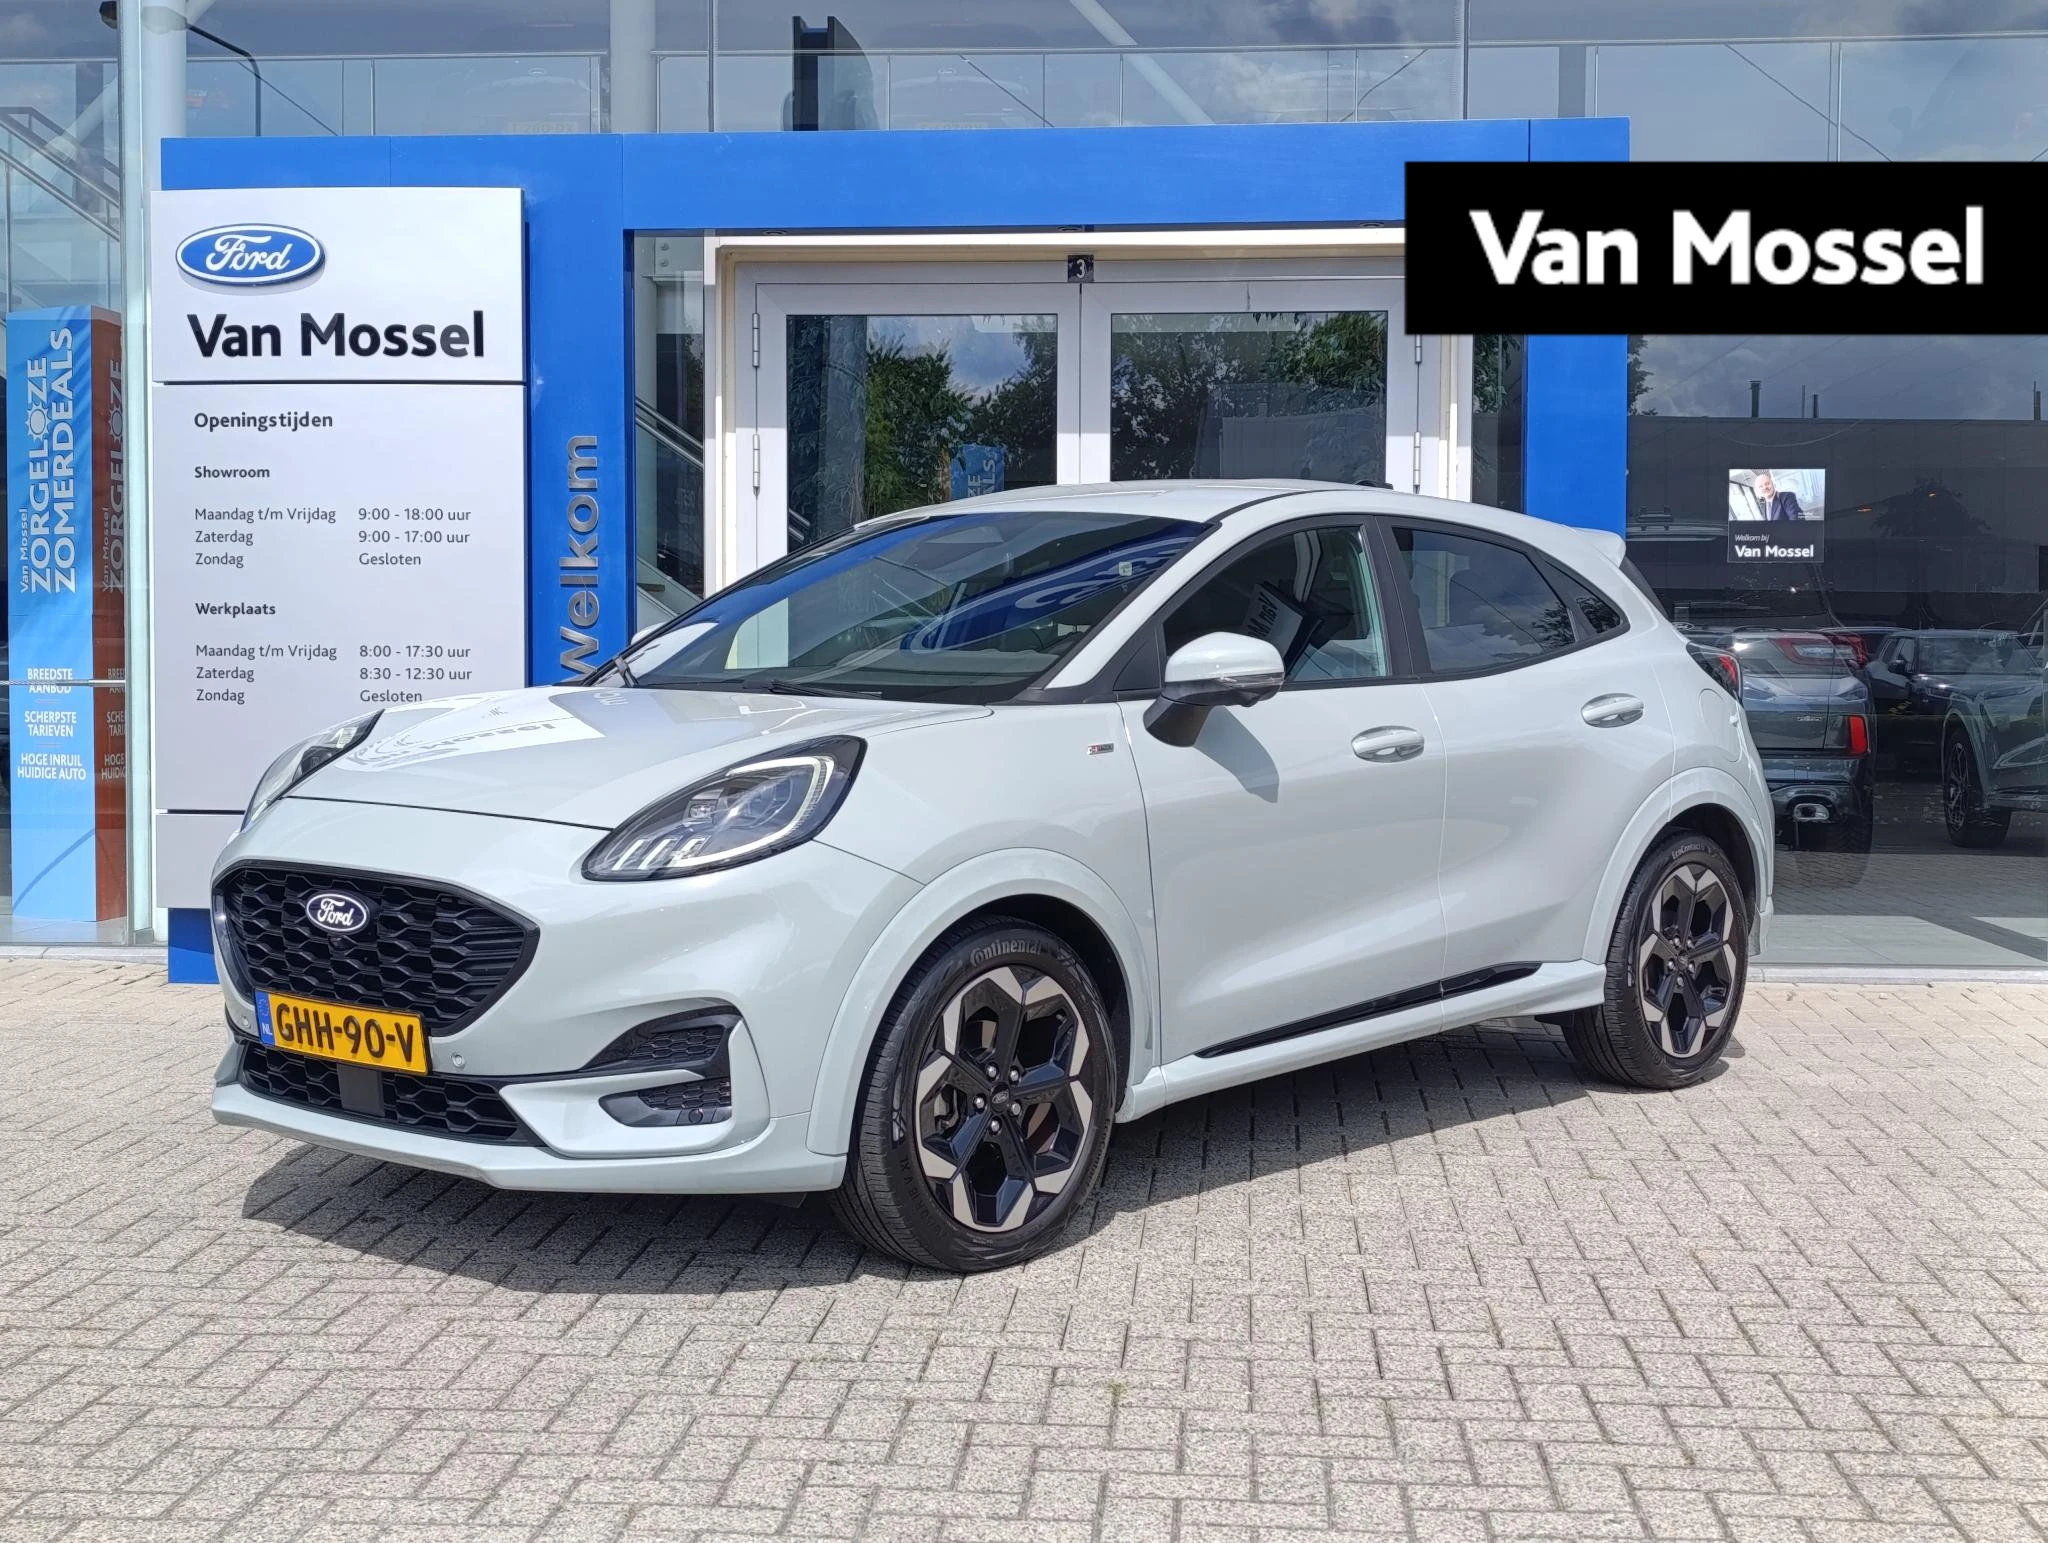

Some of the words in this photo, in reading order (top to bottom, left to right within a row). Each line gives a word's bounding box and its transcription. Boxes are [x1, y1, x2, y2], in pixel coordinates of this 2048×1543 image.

[205, 234, 293, 271] Ford
[1077, 259, 1086, 278] 3
[186, 313, 282, 358] Van
[300, 310, 485, 358] Mossel
[194, 411, 333, 433] Openingstijden
[50, 327, 76, 593] ZOMERDEALS
[194, 465, 271, 479] Showroom
[194, 507, 255, 524] Maandag
[258, 507, 283, 521] t/m
[286, 507, 337, 524] Vrijdag
[358, 507, 391, 521] 9:00
[403, 507, 444, 521] 18:00
[447, 511, 472, 521] uur
[19, 507, 28, 562] Mossel
[194, 530, 254, 547] Zaterdag
[358, 530, 391, 543] 9:00
[404, 530, 443, 544] 17:00
[446, 534, 471, 544] uur
[1735, 534, 1760, 542] Welkom
[1761, 534, 1770, 543] bij
[195, 551, 245, 569] Zondag
[358, 552, 422, 566] Gesloten
[560, 435, 600, 682] Welkom
[1734, 545, 1761, 558] Van
[1765, 544, 1815, 558] Mossel
[20, 564, 29, 593] Van
[194, 601, 276, 619] Werkplaats
[195, 643, 256, 661] Maandag
[259, 643, 284, 657] t/m
[287, 644, 337, 661] Vrijdag
[359, 644, 392, 658] 8:00
[405, 645, 444, 658] 17:30
[447, 648, 471, 658] uur
[27, 668, 73, 680] BREEDSTE
[196, 666, 255, 683] Zaterdag
[359, 667, 392, 680] 8:30
[405, 667, 445, 680] 12:30
[448, 670, 473, 680] uur
[29, 685, 72, 694] AANBOD
[196, 688, 246, 706] Zondag
[359, 688, 423, 701] Gesloten
[24, 711, 77, 723] SCHERPSTE
[106, 711, 125, 723] SCHE
[28, 724, 74, 737] TARIEVEN
[21, 753, 49, 765] HOGE
[50, 753, 83, 767] INRUIL
[17, 766, 57, 779] HUIDIGE
[58, 767, 87, 780] AUTO
[317, 897, 355, 926] Ford
[969, 939, 1042, 967] Continental
[261, 1022, 273, 1036] NL
[276, 1002, 415, 1063] GHH-90-V
